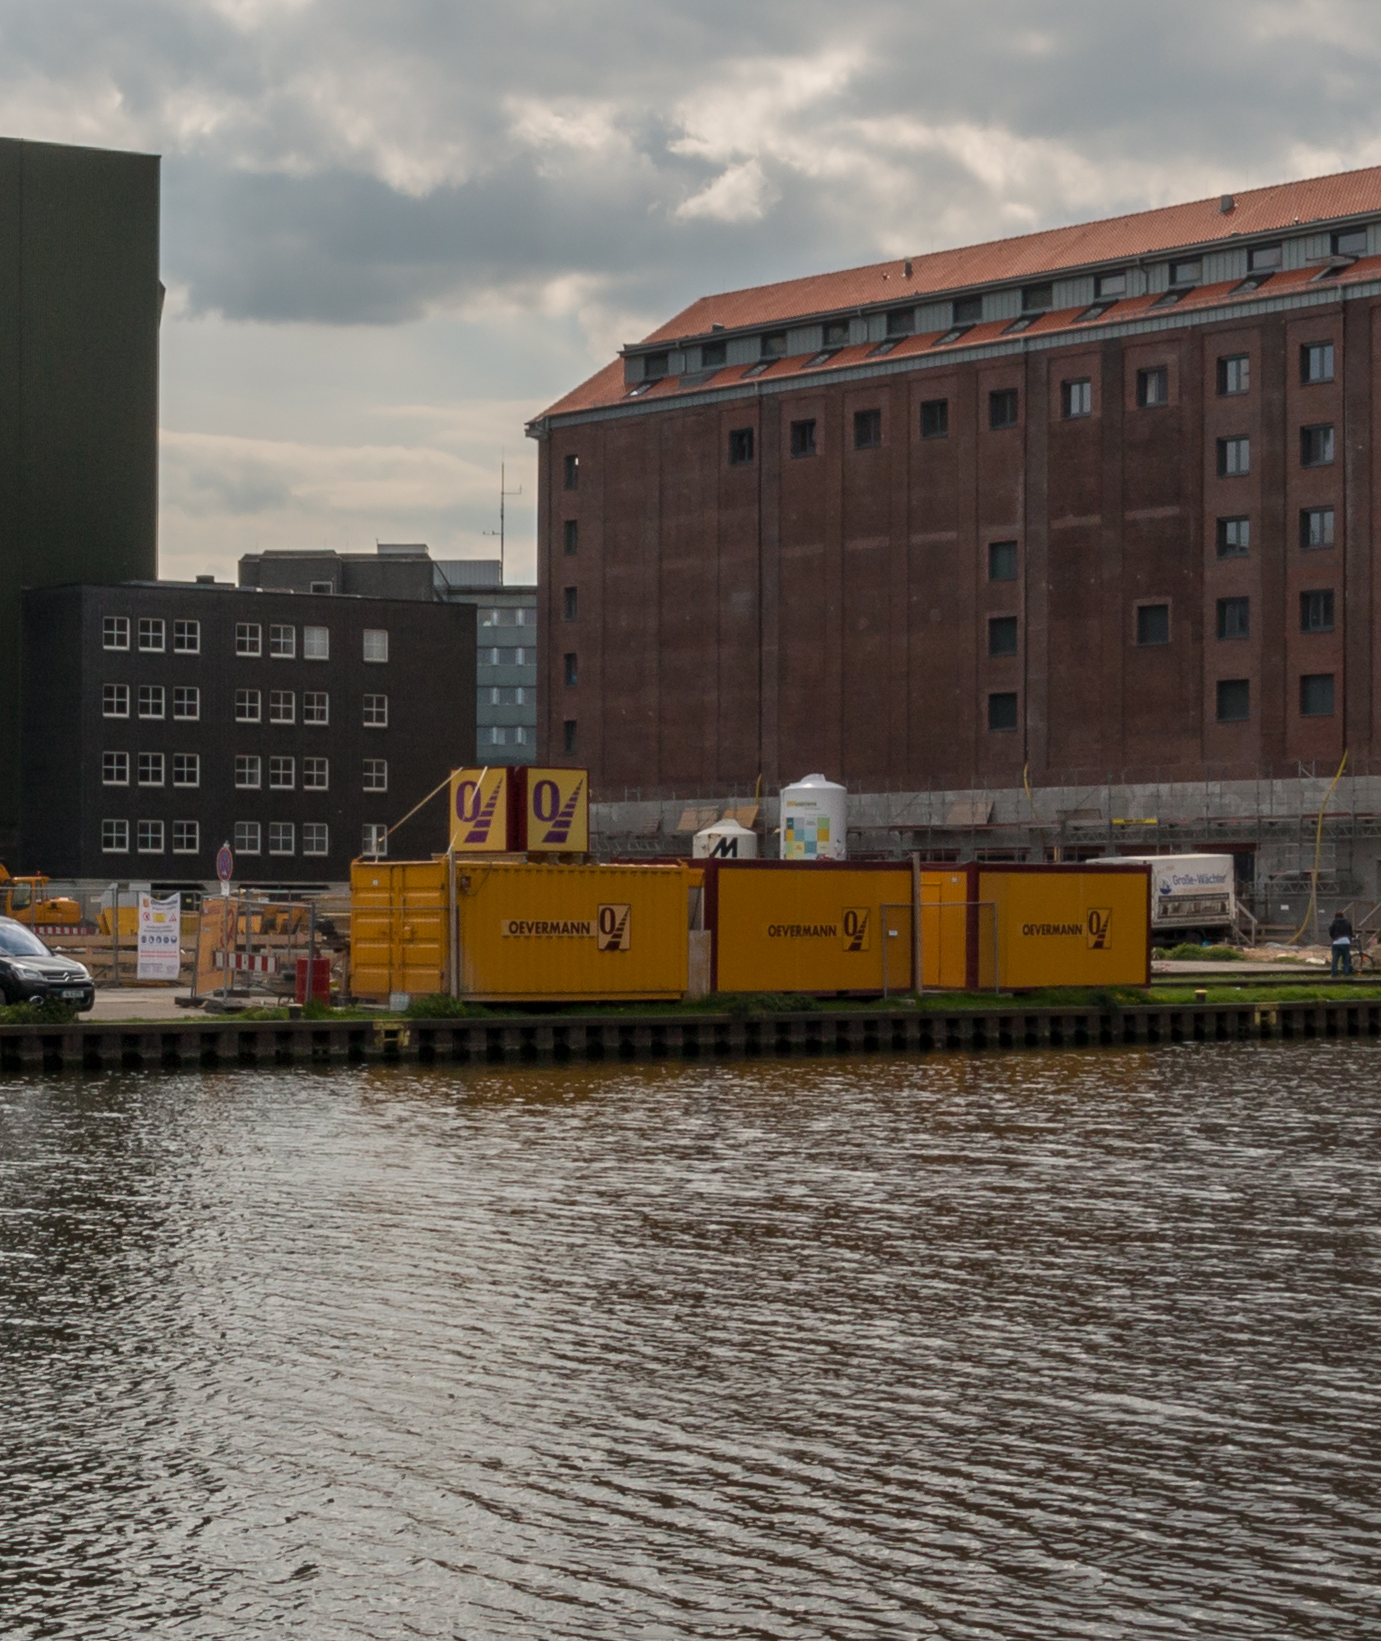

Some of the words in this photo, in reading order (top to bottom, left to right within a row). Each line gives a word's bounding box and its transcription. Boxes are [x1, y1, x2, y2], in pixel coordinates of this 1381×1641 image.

[508, 921, 591, 935] OEVERMANN
[767, 924, 837, 937] OEVERMANN
[1022, 924, 1083, 936] OEVERMANN
